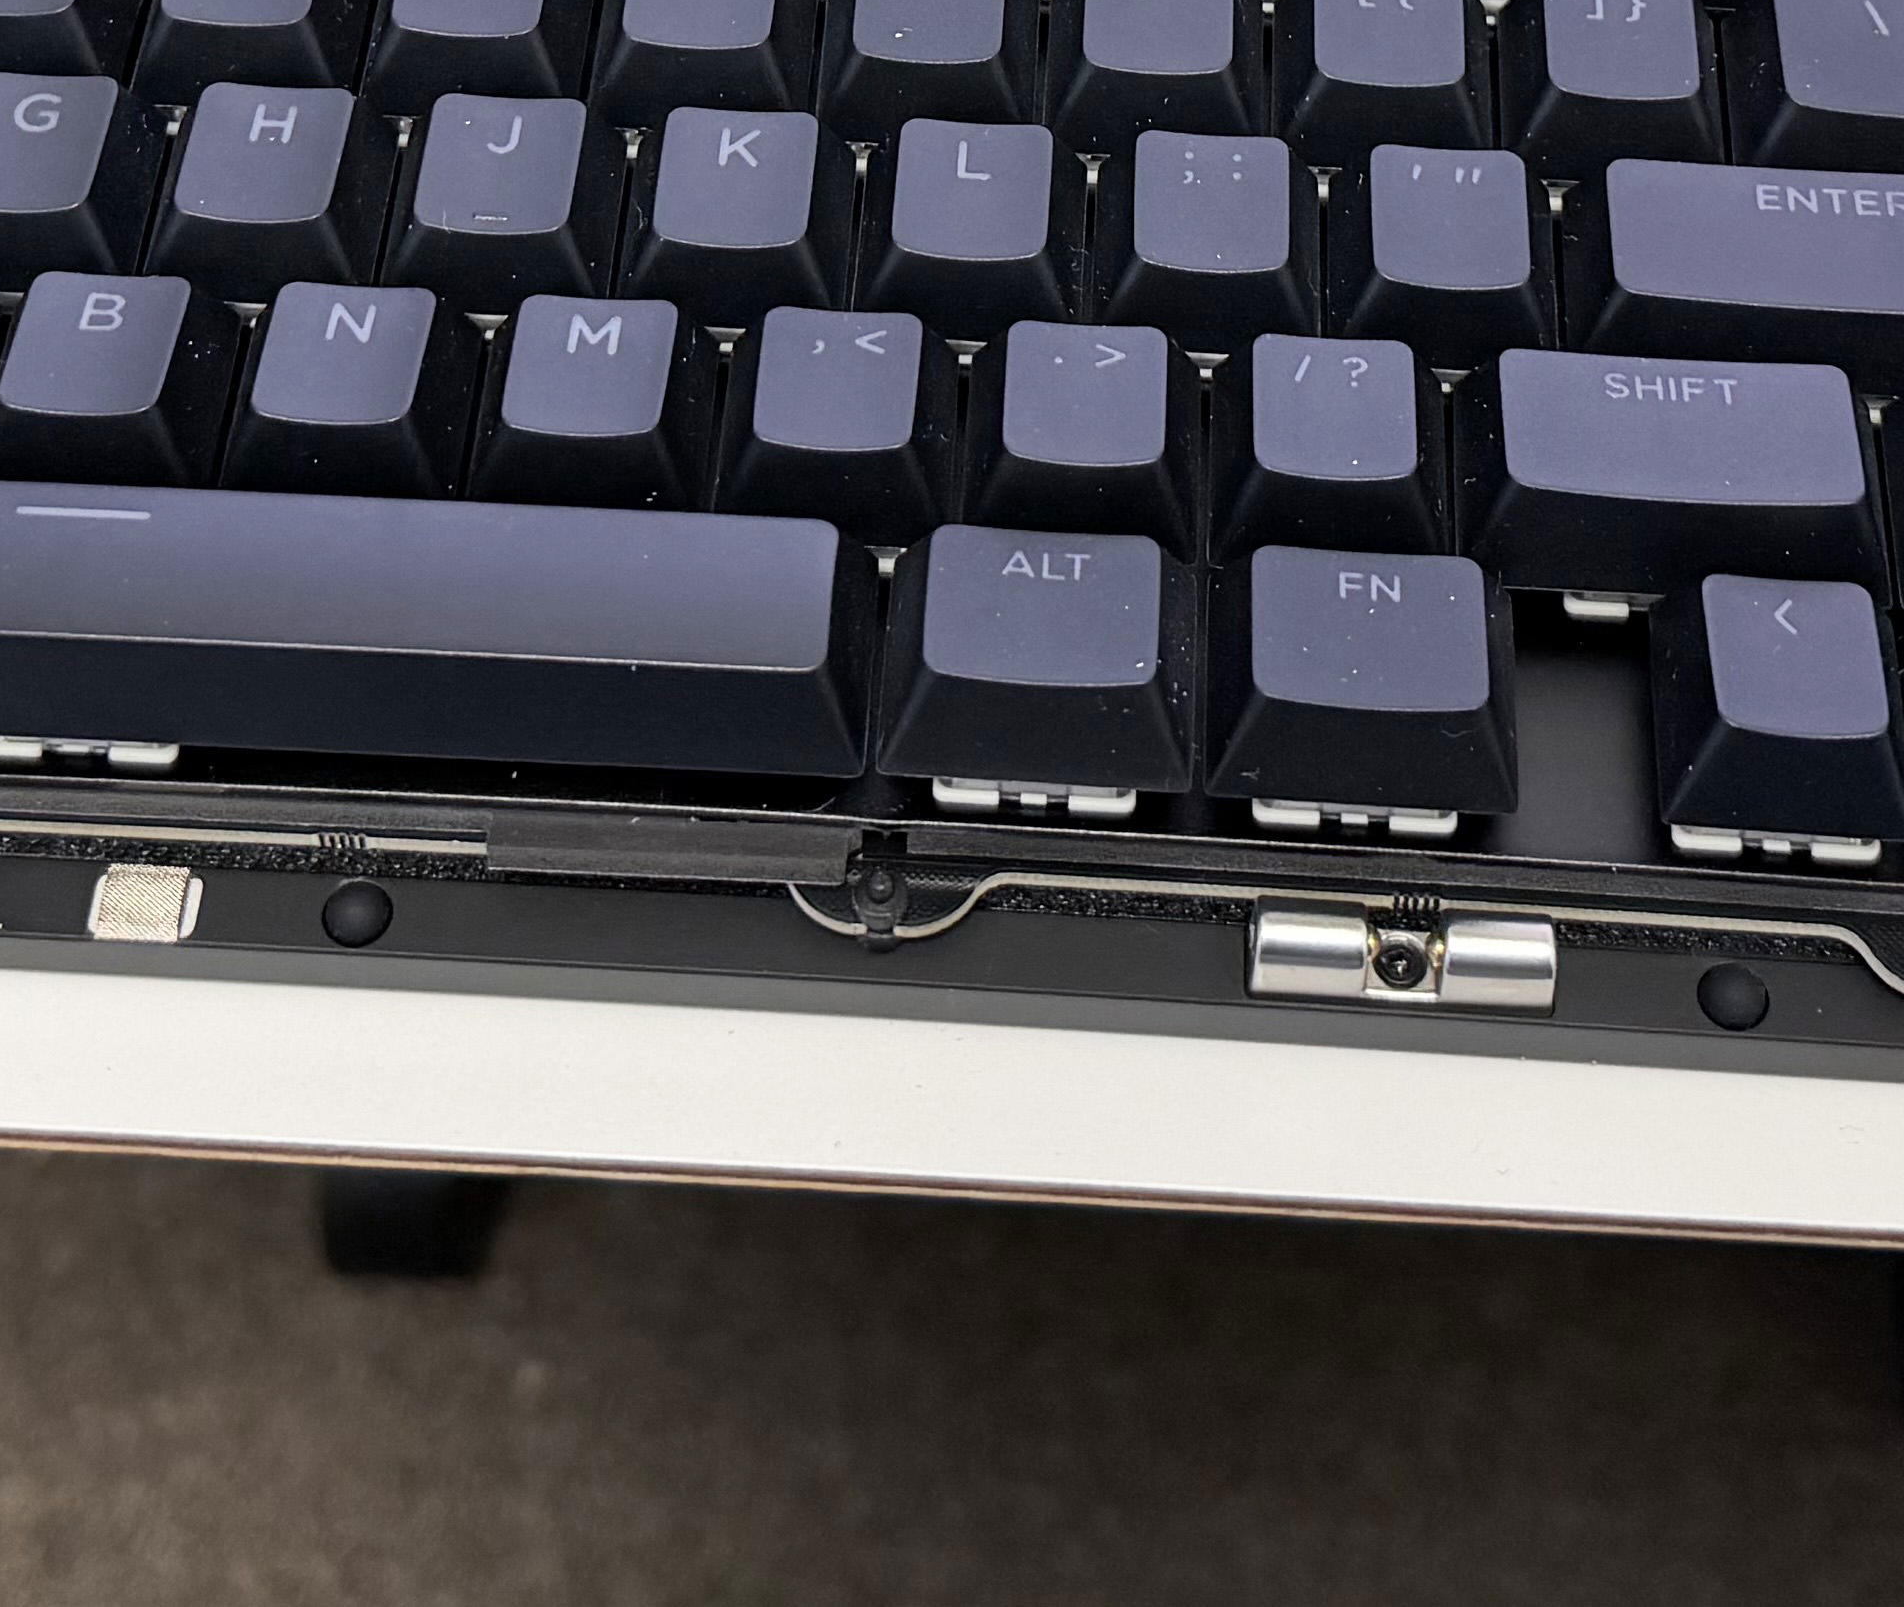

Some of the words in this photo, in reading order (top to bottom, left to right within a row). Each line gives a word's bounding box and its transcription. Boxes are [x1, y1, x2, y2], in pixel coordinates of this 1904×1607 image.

[13, 92, 62, 133] G
[248, 103, 298, 145] H
[486, 115, 523, 155] J
[718, 126, 761, 168] K
[956, 140, 991, 181] L
[78, 291, 127, 331] B
[325, 302, 377, 344] N
[566, 314, 623, 356] M
[1604, 372, 1738, 406] SHIFT
[1001, 550, 1091, 581] ALT
[1338, 571, 1401, 603] FN
